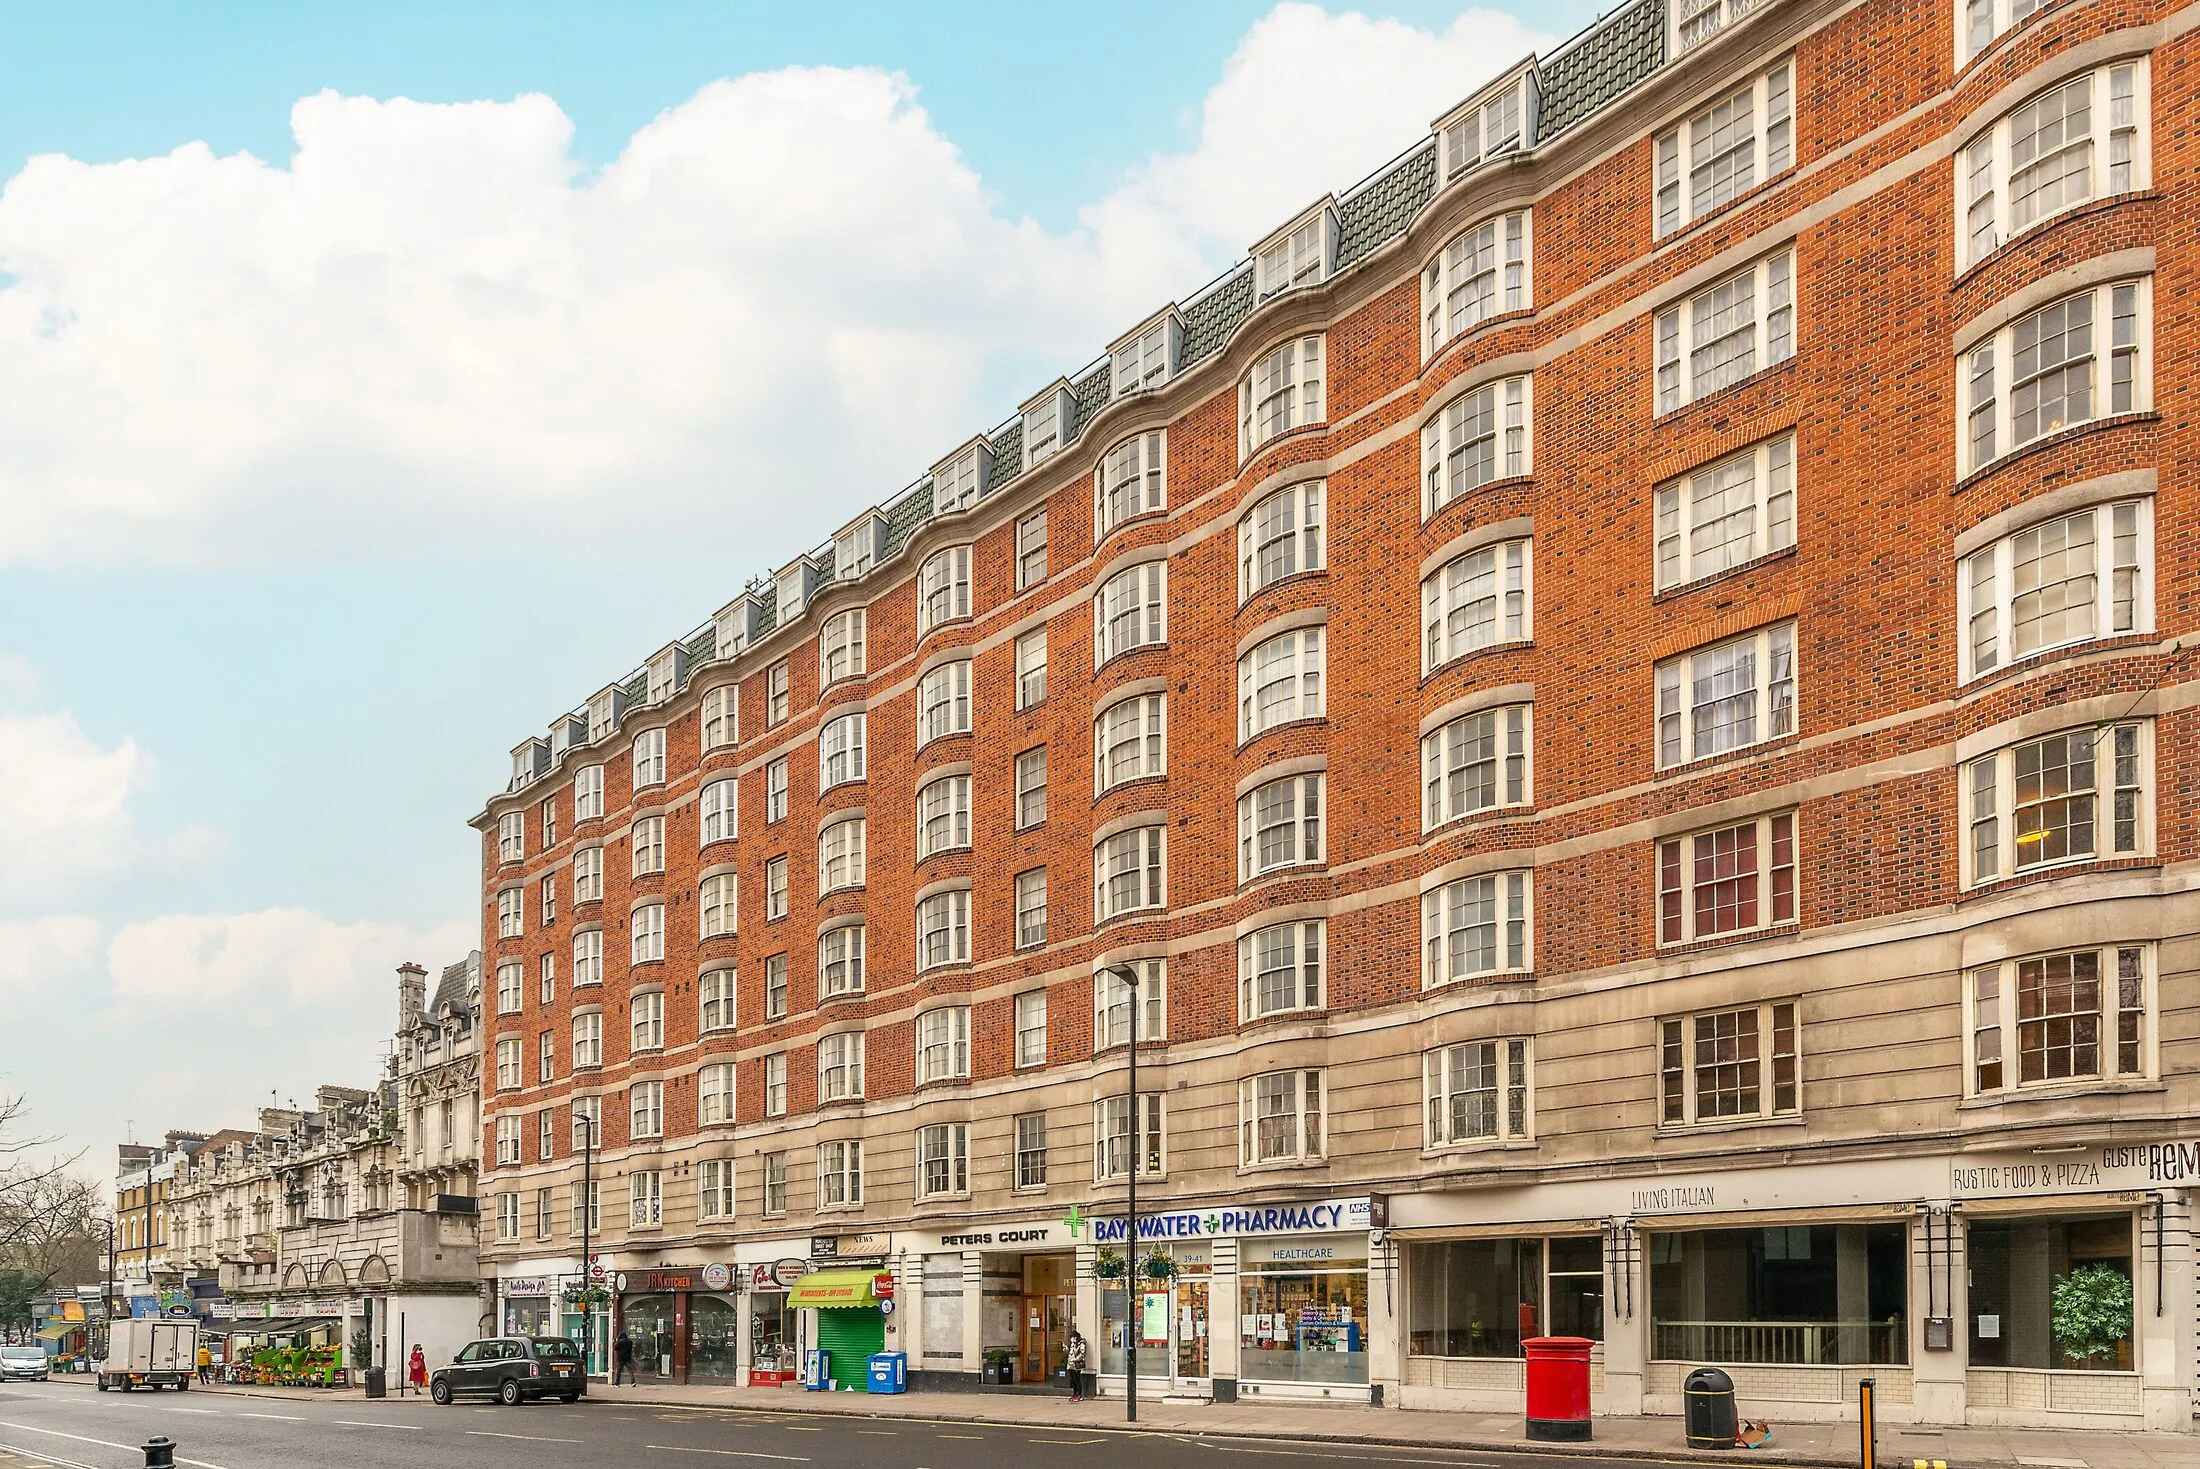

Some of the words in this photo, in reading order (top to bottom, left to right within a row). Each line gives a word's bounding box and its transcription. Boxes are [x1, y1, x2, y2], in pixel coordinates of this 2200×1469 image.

[1954, 1167, 1999, 1190] RUSTIC
[2004, 1165, 2036, 1188] FOOD
[2042, 1164, 2052, 1187] &
[2057, 1163, 2100, 1186] PIZZA
[1632, 1188, 1668, 1209] LIVING
[1671, 1186, 1715, 1207] ITALIAN
[1350, 1203, 1370, 1213] NHS
[1095, 1216, 1201, 1241] BAYWATER
[1222, 1204, 1343, 1233] PHARMACY
[854, 1235, 874, 1244] NEWS
[941, 1233, 992, 1246] PETERS
[999, 1229, 1048, 1243] COURT
[1184, 1255, 1203, 1263] 39-41
[1273, 1248, 1333, 1259] HEALTHCARE
[1063, 1279, 1076, 1287] PET
